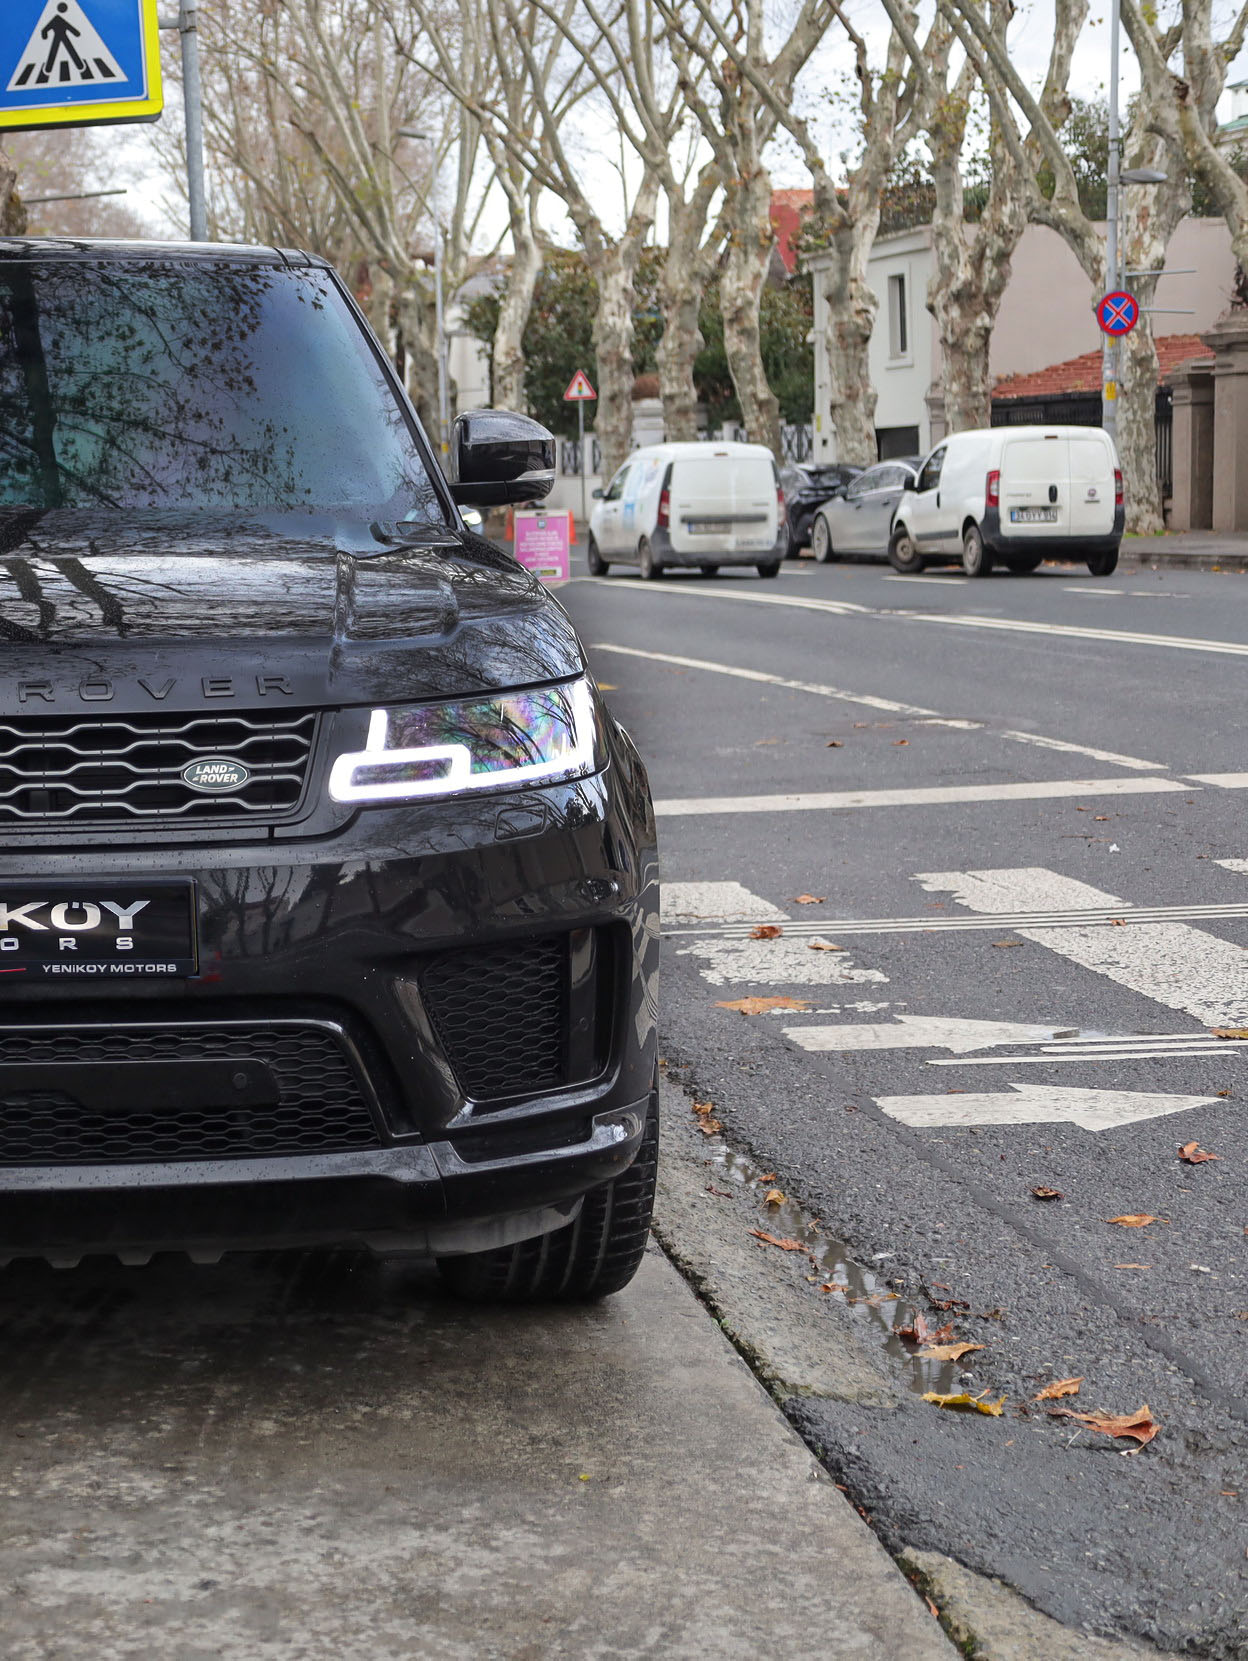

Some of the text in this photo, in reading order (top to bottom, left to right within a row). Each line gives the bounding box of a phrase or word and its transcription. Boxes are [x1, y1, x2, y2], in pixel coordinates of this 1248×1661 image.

[18, 674, 294, 702] ROVER
[195, 764, 228, 775] LAND
[199, 773, 238, 784] ROVER
[110, 963, 177, 973] MOTORS
